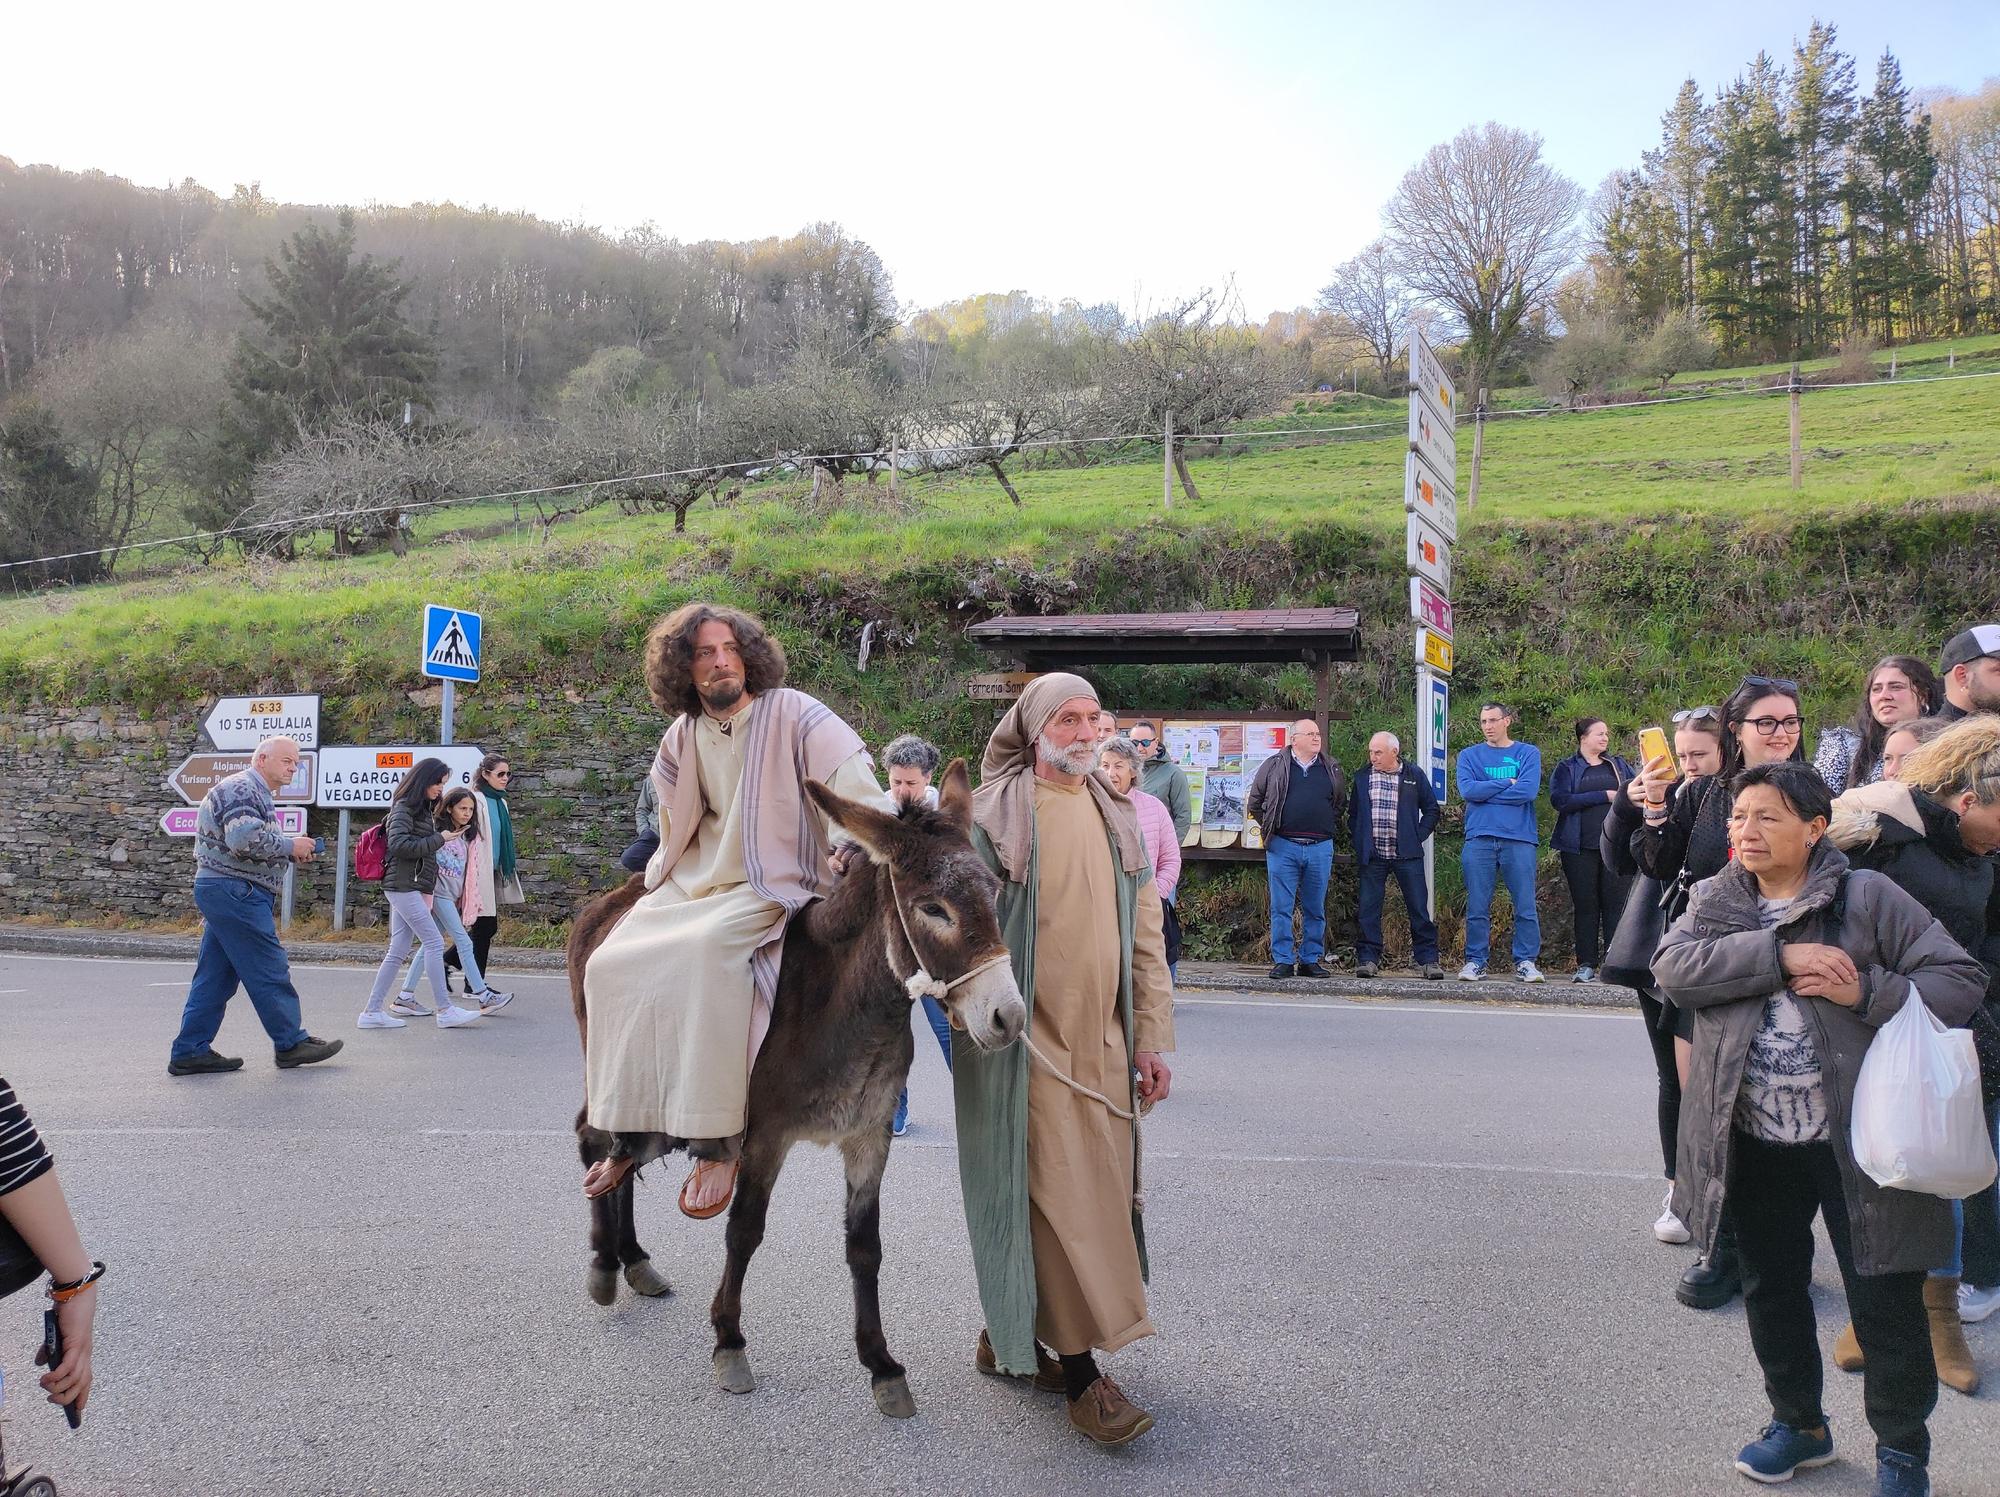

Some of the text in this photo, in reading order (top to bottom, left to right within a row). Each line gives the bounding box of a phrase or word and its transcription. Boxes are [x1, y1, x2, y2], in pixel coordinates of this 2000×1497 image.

[1005, 680, 1025, 693] Sant
[250, 702, 282, 713] AS-33
[218, 716, 313, 731] 10 STA EULALIA
[380, 755, 409, 766] AS-11
[180, 774, 212, 784] Turismo
[325, 771, 342, 784] LA
[461, 771, 471, 784] 6
[325, 788, 392, 802] VEGADEO
